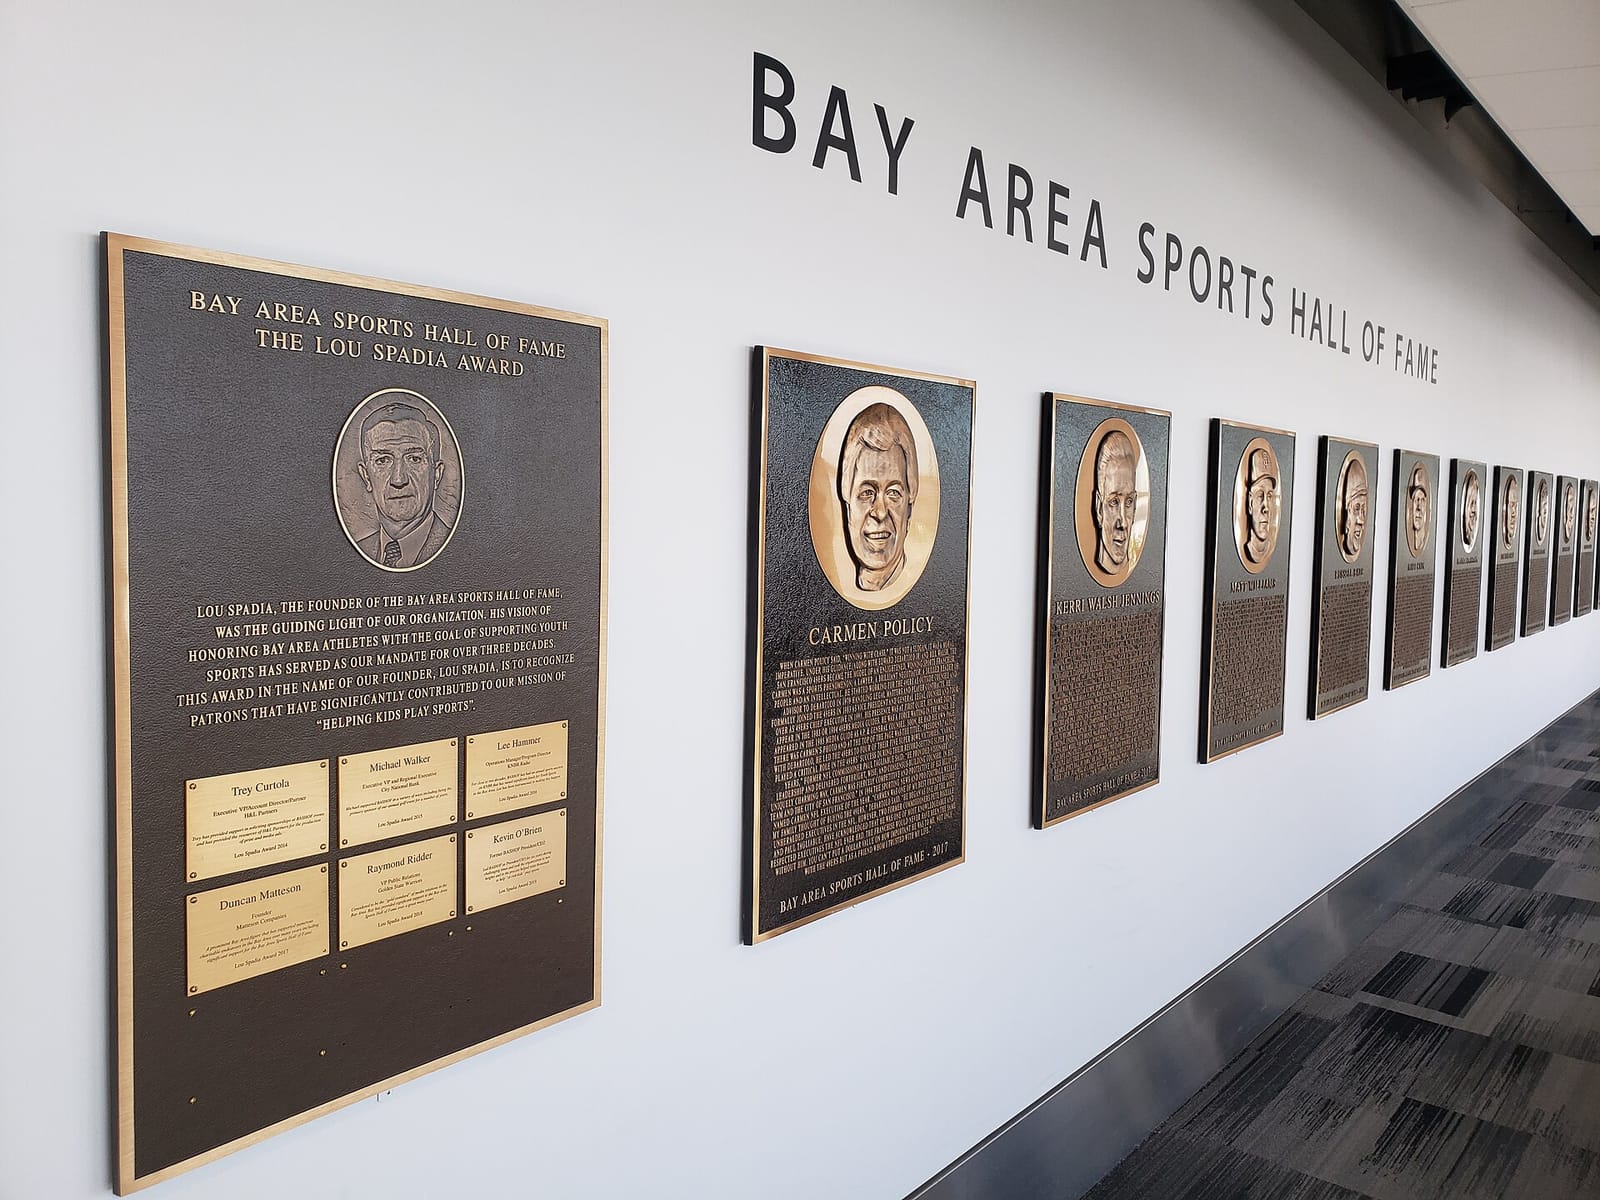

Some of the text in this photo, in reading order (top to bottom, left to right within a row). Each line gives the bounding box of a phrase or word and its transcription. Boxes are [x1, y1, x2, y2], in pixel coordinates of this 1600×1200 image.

[752, 51, 1438, 384] BAY AREA SPORTS HALL OF FAME
[189, 290, 566, 359] BAY AREA SPORTS HALL OF FAME
[255, 328, 524, 377] THE LOU SPADIA AWARD
[197, 587, 563, 618] LOU SPADIA, THE FOUNDER OF THE BAY AREA SPORTS HALL OF FAME,
[1056, 591, 1160, 615] KERRI WALSH JENNINGS
[215, 605, 551, 639] WAS THE GUIDING LIGHT OF OUR ORGANIZATION. HIS VISION OF
[809, 616, 934, 646] CARMEN POLICY
[189, 620, 568, 662] HONORING BAY AREA ATHLETES WITH THE GOAL OF SUPPORTING YOUTH
[206, 638, 556, 682] SPORTS HAS SERVED AS OUR MANDATE FOR OVER THREE DECADES.
[177, 653, 575, 707] THIS AWARD IN THE NAME OF OUR FOUNDER, LOU SPADIA, IS TO RECOGNIZE
[191, 671, 566, 727] PATRONS THAT HAVE SIGNIFICANTLY CONTRIBUTED TO OUR MISSION OF
[376, 709, 400, 723] KIDS
[404, 705, 430, 720] PLAY
[497, 737, 541, 750] Lee Hammer
[369, 755, 430, 772] Michael Walker
[232, 779, 290, 796] Trey Curtola
[362, 781, 382, 789] Executive
[400, 775, 417, 783] Regional
[213, 796, 306, 816] Executive VP/Account Director/Partner
[493, 833, 513, 843] Kevin
[245, 849, 260, 857] Spadia
[262, 845, 276, 853] Award
[367, 852, 432, 874] Raymond Ridder
[780, 842, 949, 913] BAY AREA SPORTS HALL OF FAME 2017
[220, 884, 301, 910] Duncan Matteson
[236, 914, 286, 930] Matteson Companies
[251, 910, 272, 919] Founder
